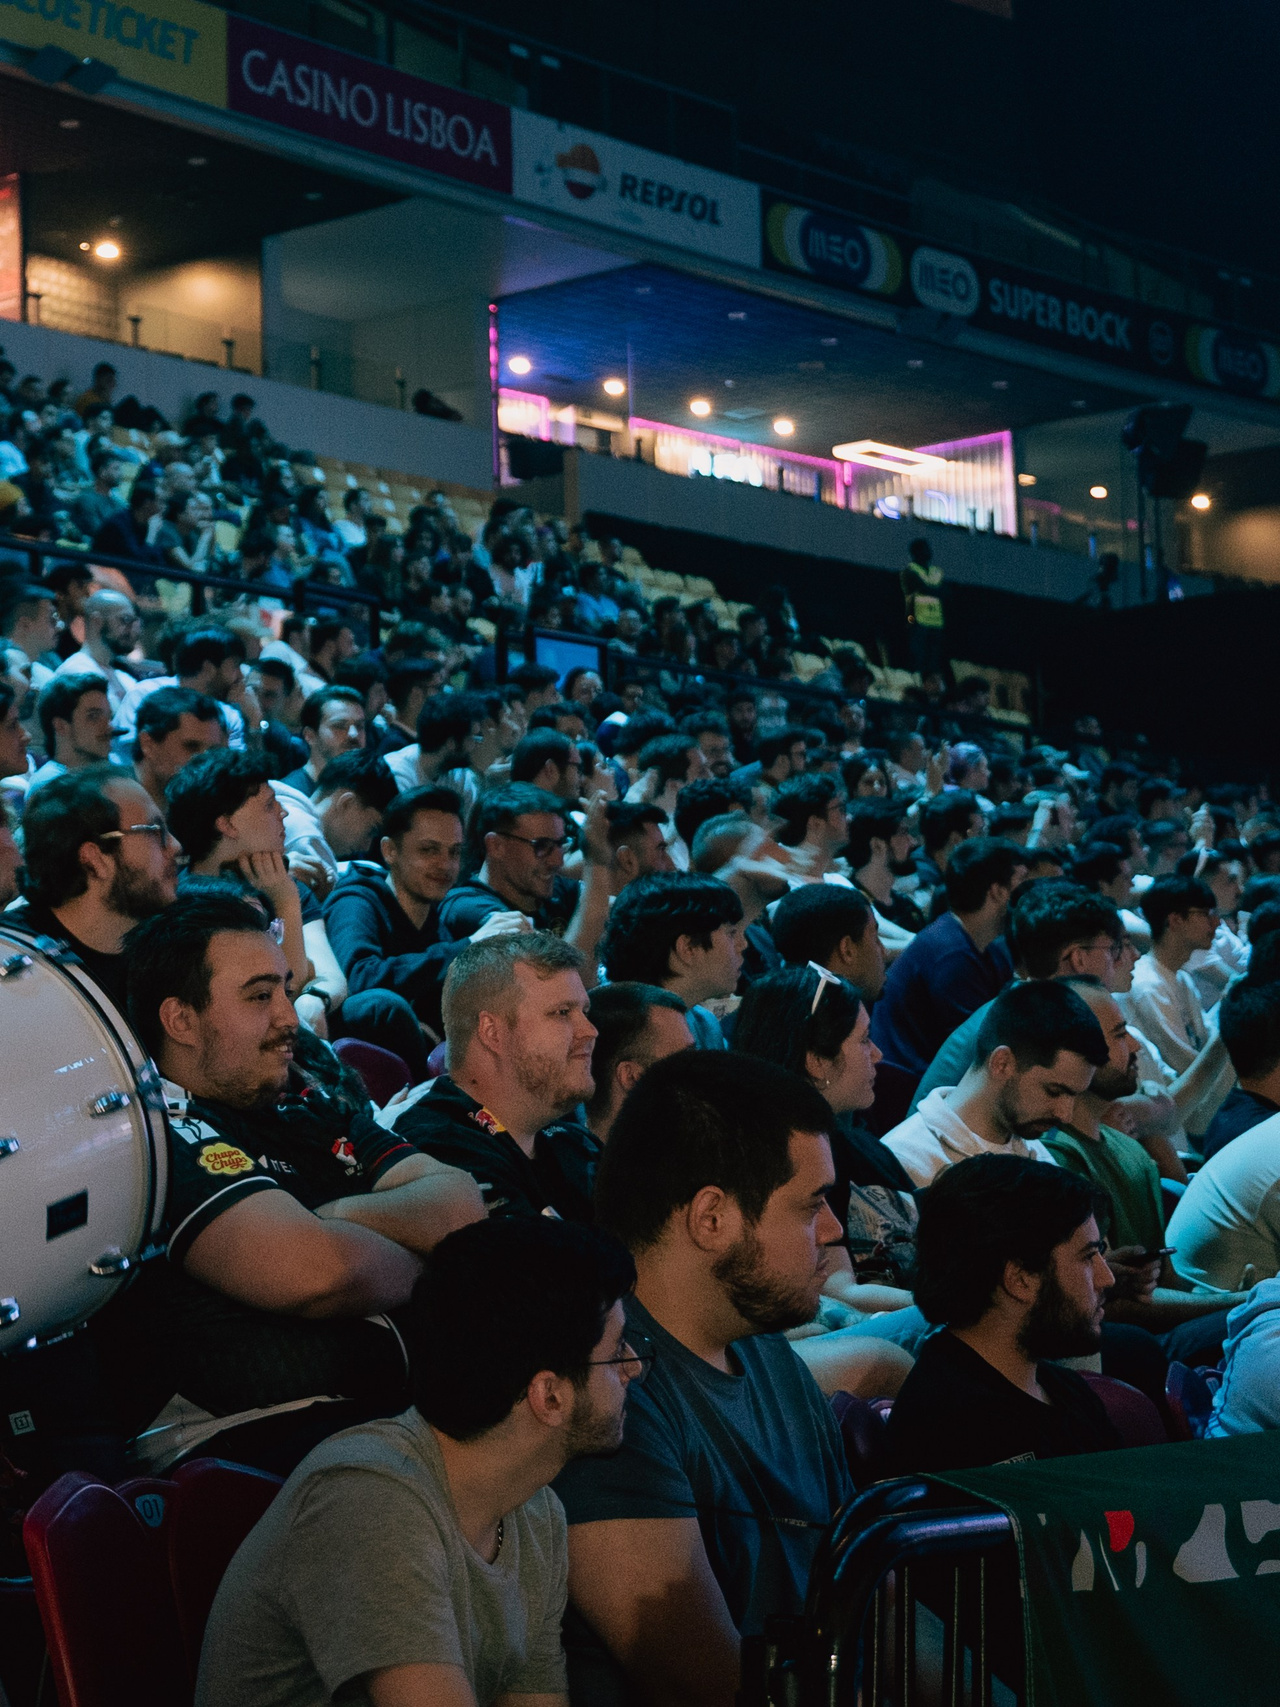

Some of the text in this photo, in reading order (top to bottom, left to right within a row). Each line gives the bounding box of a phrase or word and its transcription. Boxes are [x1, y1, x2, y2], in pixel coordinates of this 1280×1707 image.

[241, 48, 500, 167] CASINO LISBOA
[619, 171, 723, 228] REPSOL
[808, 226, 864, 272] MEO
[921, 260, 972, 302] MEO
[987, 275, 1064, 333] SUPER
[1065, 300, 1133, 352] BOCK
[205, 1149, 240, 1163] Chupa
[211, 1157, 248, 1171] Chups
